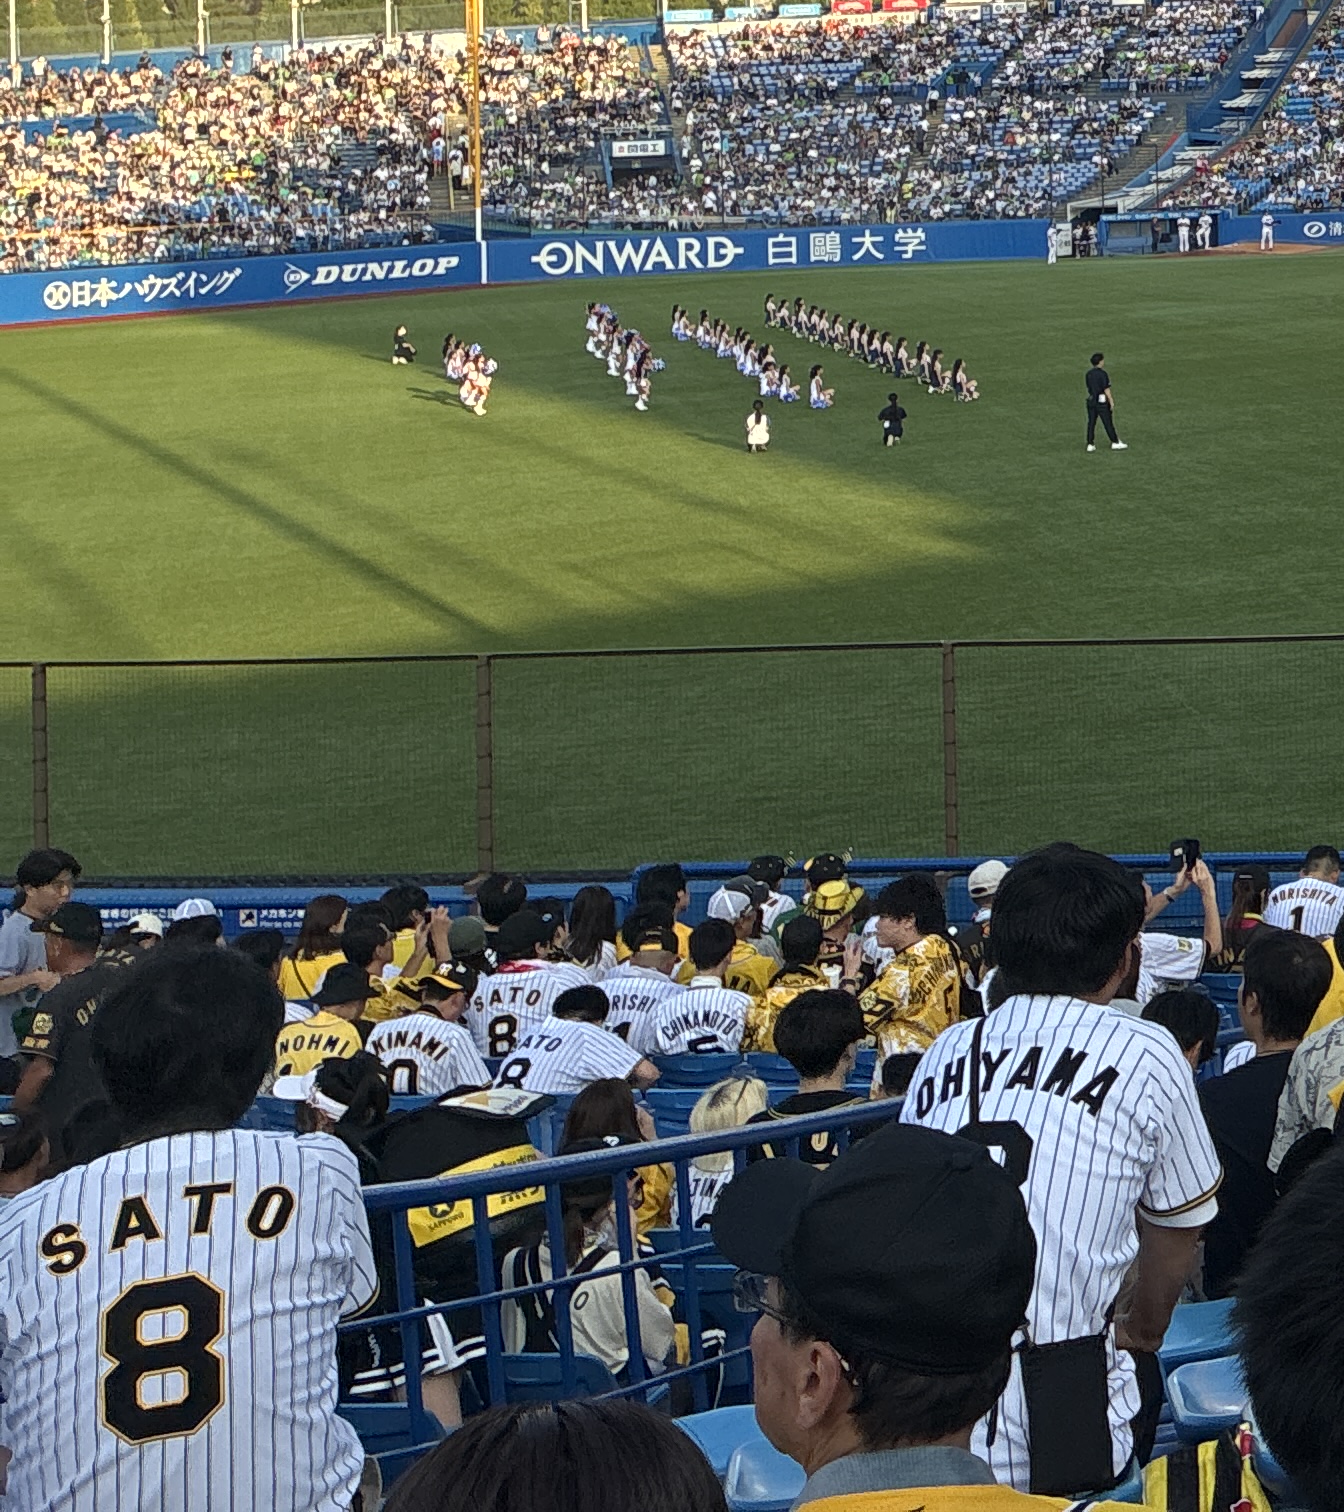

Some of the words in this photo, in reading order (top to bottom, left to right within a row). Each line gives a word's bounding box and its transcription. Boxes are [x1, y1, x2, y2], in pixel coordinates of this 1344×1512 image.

[312, 255, 460, 286] DUNLOP
[530, 235, 745, 276] ONWARD
[72, 266, 243, 309] 日本ハウズイング
[1272, 884, 1338, 907] MORISHITA
[1290, 904, 1304, 931] 1
[474, 985, 542, 1013] SATO
[488, 1014, 518, 1058] 8
[663, 1010, 739, 1042] CHIKAMOTO
[279, 1033, 352, 1058] NOHMI
[372, 1029, 449, 1063] KINAMI
[916, 1045, 1120, 1119] OHYAMA
[40, 1181, 297, 1276] SATO
[102, 1271, 226, 1445] 8
